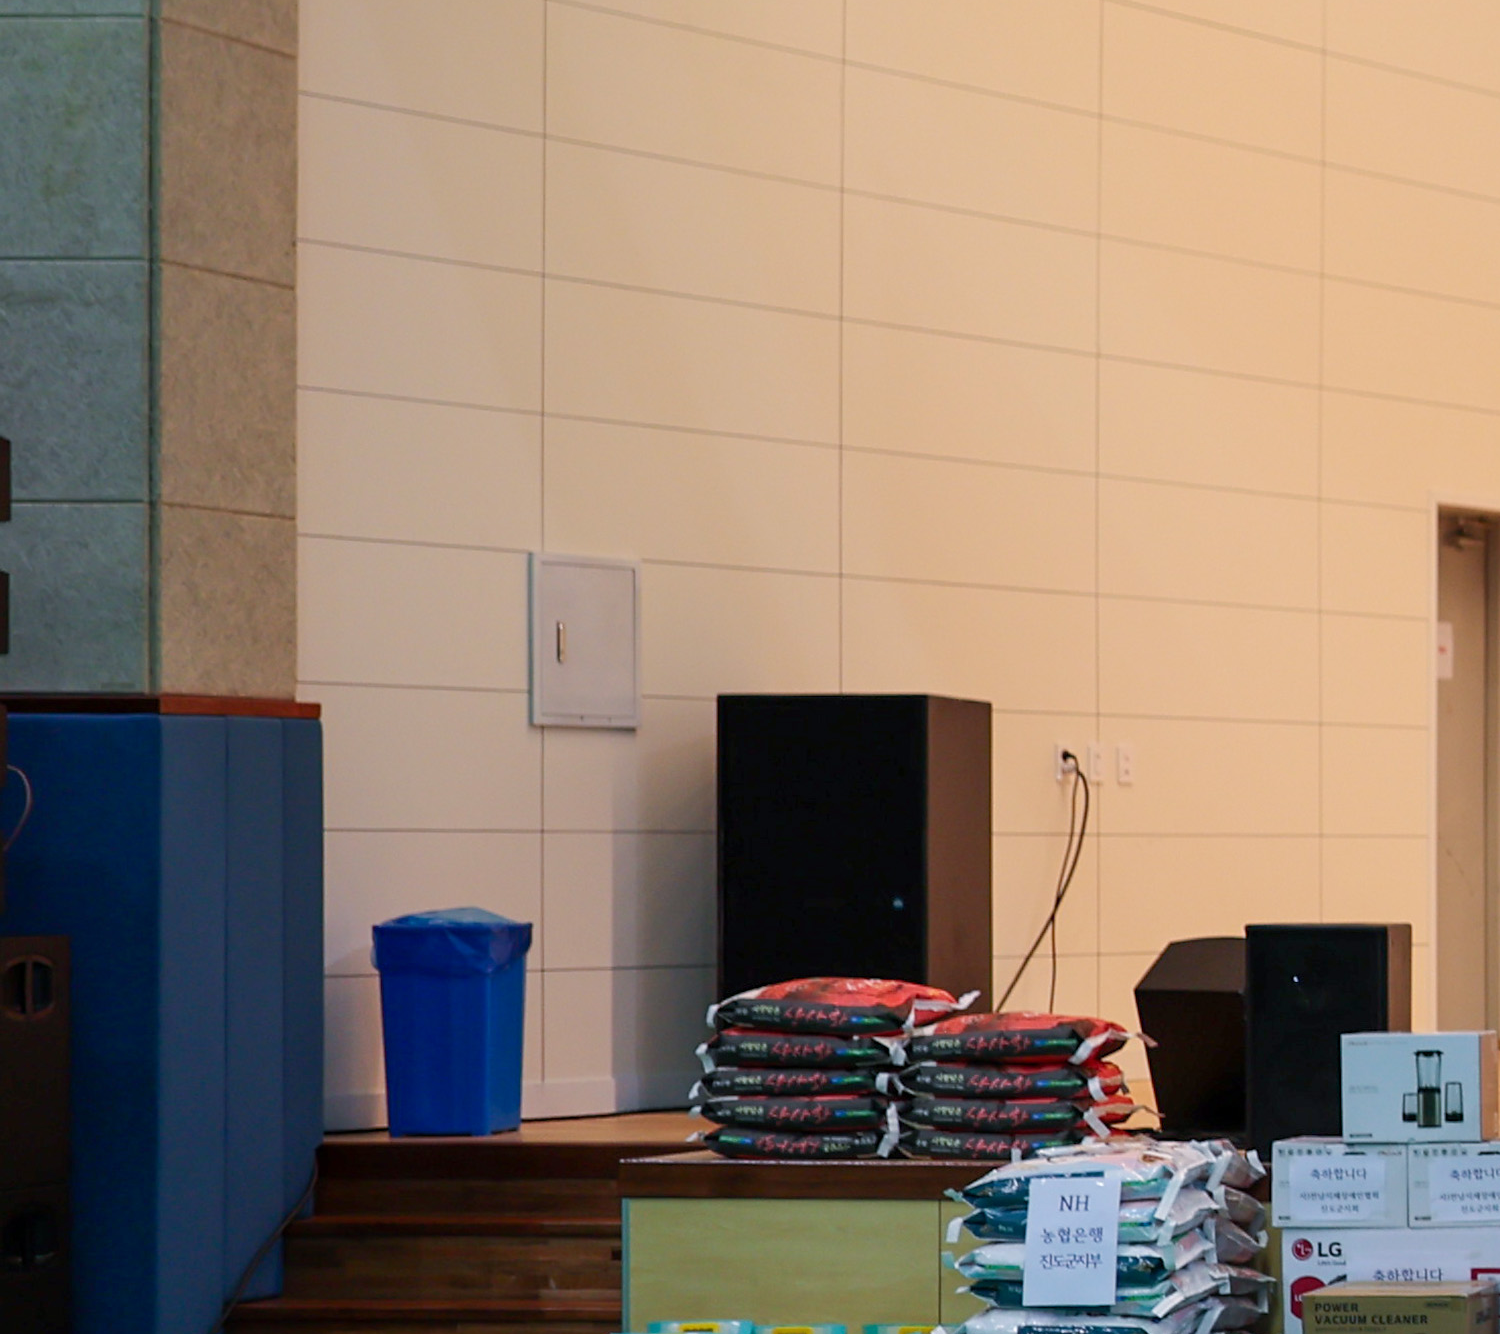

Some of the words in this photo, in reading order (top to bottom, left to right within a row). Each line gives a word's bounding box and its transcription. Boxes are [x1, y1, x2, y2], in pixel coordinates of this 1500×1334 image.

[1058, 1194, 1090, 1213] NH
[1040, 1226, 1104, 1245] 농협은행
[1316, 1241, 1343, 1258] LG
[1314, 1302, 1359, 1313] POWER
[1314, 1314, 1367, 1325] VACUUM
[1371, 1314, 1429, 1325] CLEANER
